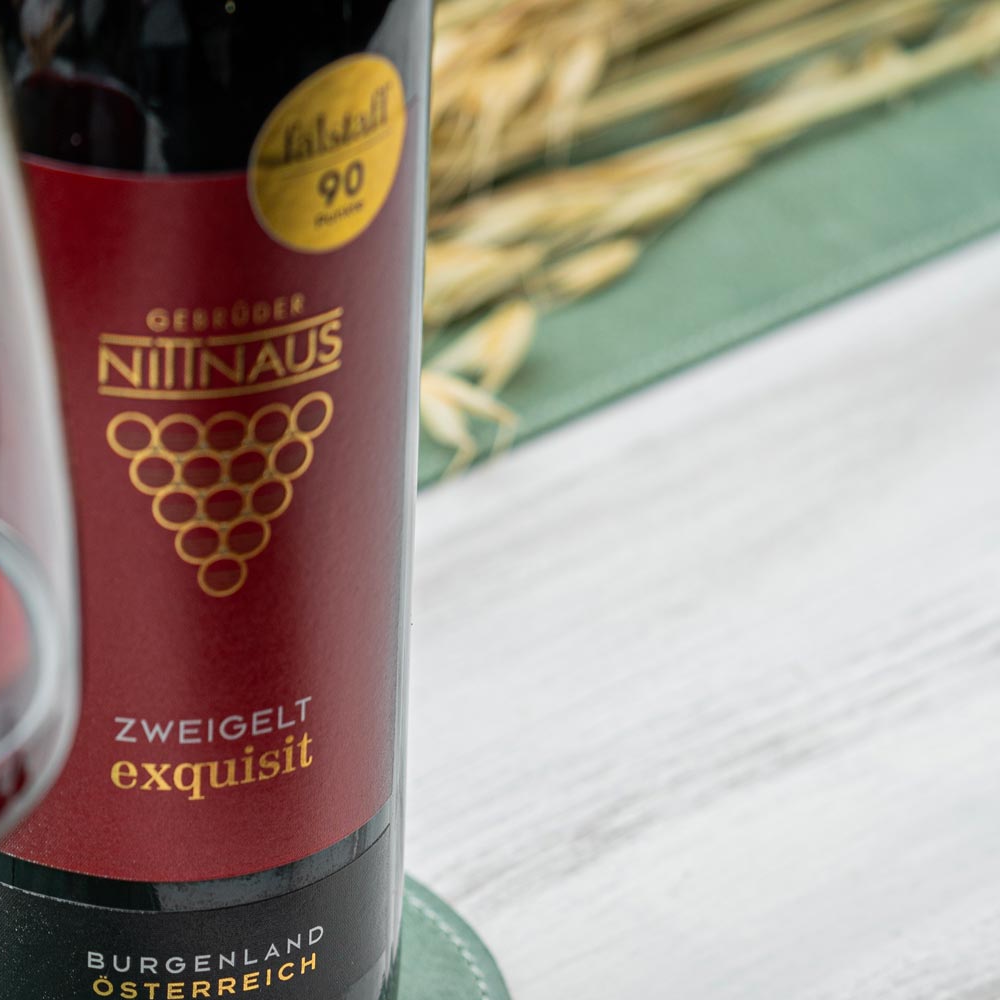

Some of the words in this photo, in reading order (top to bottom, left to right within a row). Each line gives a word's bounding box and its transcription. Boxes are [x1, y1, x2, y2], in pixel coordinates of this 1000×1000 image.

[317, 161, 364, 206] 90
[146, 294, 305, 333] GEBRÜDER
[98, 320, 343, 390] NITTNAUS
[114, 696, 312, 744] ZWEIGELT
[110, 732, 313, 800] exquisit
[87, 925, 324, 974] BURGENLAND
[92, 952, 316, 1000] ÖSTERREICH
